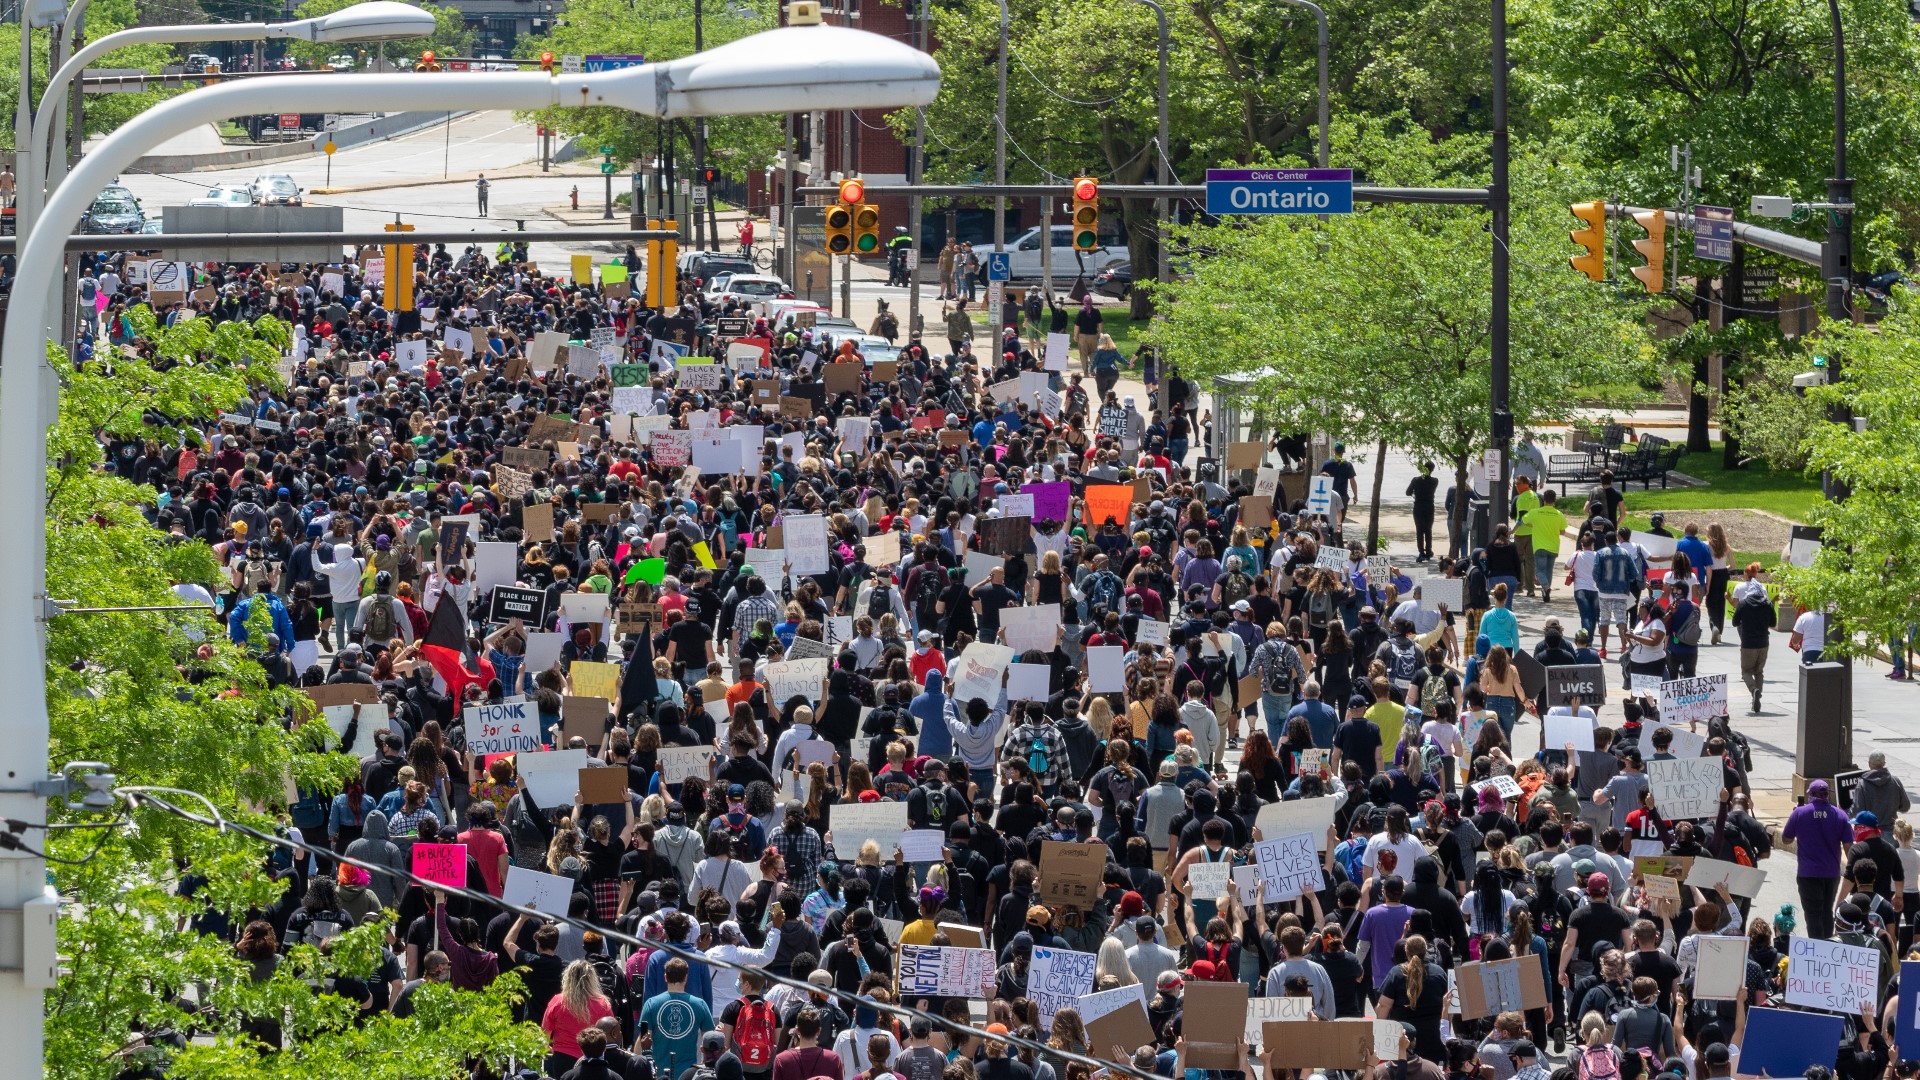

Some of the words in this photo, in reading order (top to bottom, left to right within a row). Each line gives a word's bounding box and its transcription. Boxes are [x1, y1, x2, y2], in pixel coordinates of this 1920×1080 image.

[1251, 172, 1274, 180] Civic
[1278, 172, 1308, 180] Center
[1230, 186, 1330, 208] Ontario
[154, 282, 176, 291] ACAB
[611, 366, 648, 386] RESIST
[687, 366, 716, 374] BLACK
[680, 380, 716, 388] MATTER
[1103, 409, 1126, 418] END
[1100, 417, 1127, 428] WHITE
[1100, 425, 1127, 438] SILENCE
[1257, 480, 1275, 492] ACAB
[1368, 557, 1388, 567] BLACK
[500, 591, 518, 600] BLACK
[522, 594, 538, 602] LIVES
[506, 602, 530, 611] MATTER
[1548, 670, 1579, 680] BLACK
[1660, 683, 1669, 691] IF
[1672, 679, 1694, 690] THERE
[1696, 676, 1708, 688] IS
[1709, 674, 1727, 685] SUCH
[1560, 682, 1594, 694] LIVES
[1664, 691, 1671, 699] A
[1673, 688, 1698, 698] THING
[1698, 686, 1708, 694] AS
[480, 703, 526, 723] HONK
[480, 724, 502, 738] for
[512, 723, 522, 734] a
[467, 734, 541, 754] REVOLUTION
[660, 751, 701, 765] BLACK
[1648, 761, 1700, 784] BLACK
[1260, 839, 1312, 863] BLACK
[428, 858, 453, 870] LIVES
[1263, 855, 1313, 880] LIVES
[423, 868, 458, 880] MATTER
[1266, 870, 1320, 894] MATTER
[1794, 940, 1827, 959] OH...
[1831, 949, 1878, 968] CAUSE
[900, 958, 916, 982] YOU
[914, 946, 942, 996] NEUTRAL
[950, 948, 965, 986] INJUSTICE
[1792, 957, 1796, 973] I
[1804, 959, 1841, 980] THOT
[1849, 966, 1876, 987] THE
[900, 982, 908, 995] IF
[1033, 969, 1041, 989] I
[1046, 972, 1094, 1000] CAN'T
[1788, 978, 1832, 994] POLICE
[1840, 982, 1870, 998] SAID
[1028, 990, 1081, 1017] BREATH
[1088, 988, 1137, 1007] KARENS
[1825, 994, 1859, 1009] SUM.
[750, 1048, 760, 1060] 2
